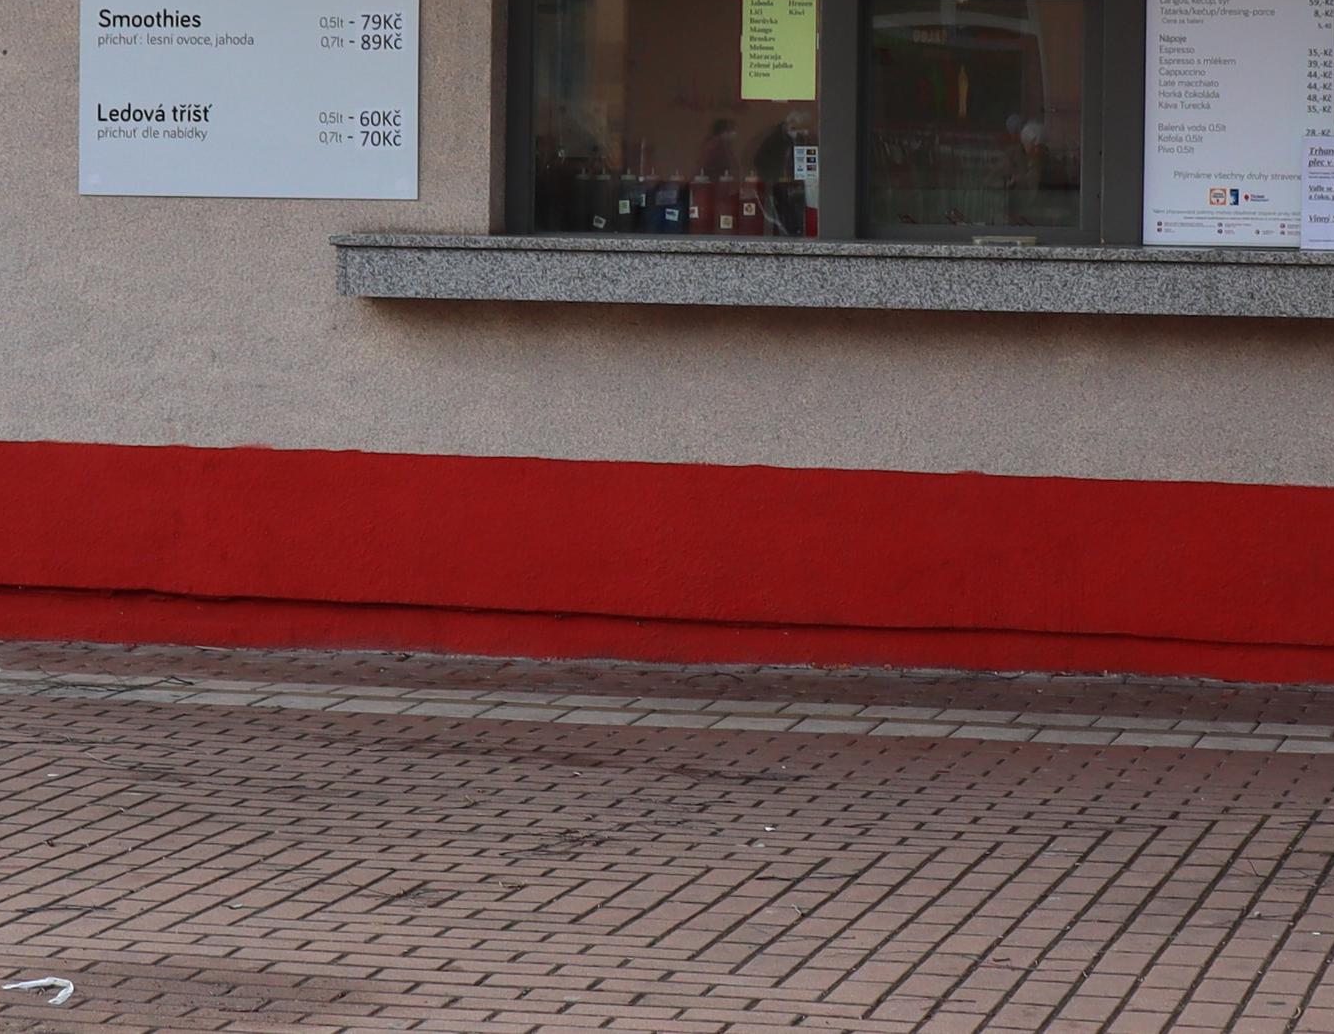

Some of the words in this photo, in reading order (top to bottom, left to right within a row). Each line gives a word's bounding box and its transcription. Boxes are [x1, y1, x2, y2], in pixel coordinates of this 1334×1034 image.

[98, 9, 202, 28] Smoothies
[361, 13, 403, 30] 79Kč
[176, 34, 213, 47] ovoce,
[215, 33, 255, 48] jahoda
[361, 33, 403, 50] 89Kč
[1159, 46, 1195, 56] Espresso
[1159, 57, 1195, 67] Espresso
[1158, 68, 1206, 78] Cappuccino
[97, 103, 166, 122] Ledová
[360, 110, 402, 127] 60Kč
[142, 127, 160, 139] dle
[163, 127, 208, 142] nabídky
[360, 130, 402, 147] 70Kč
